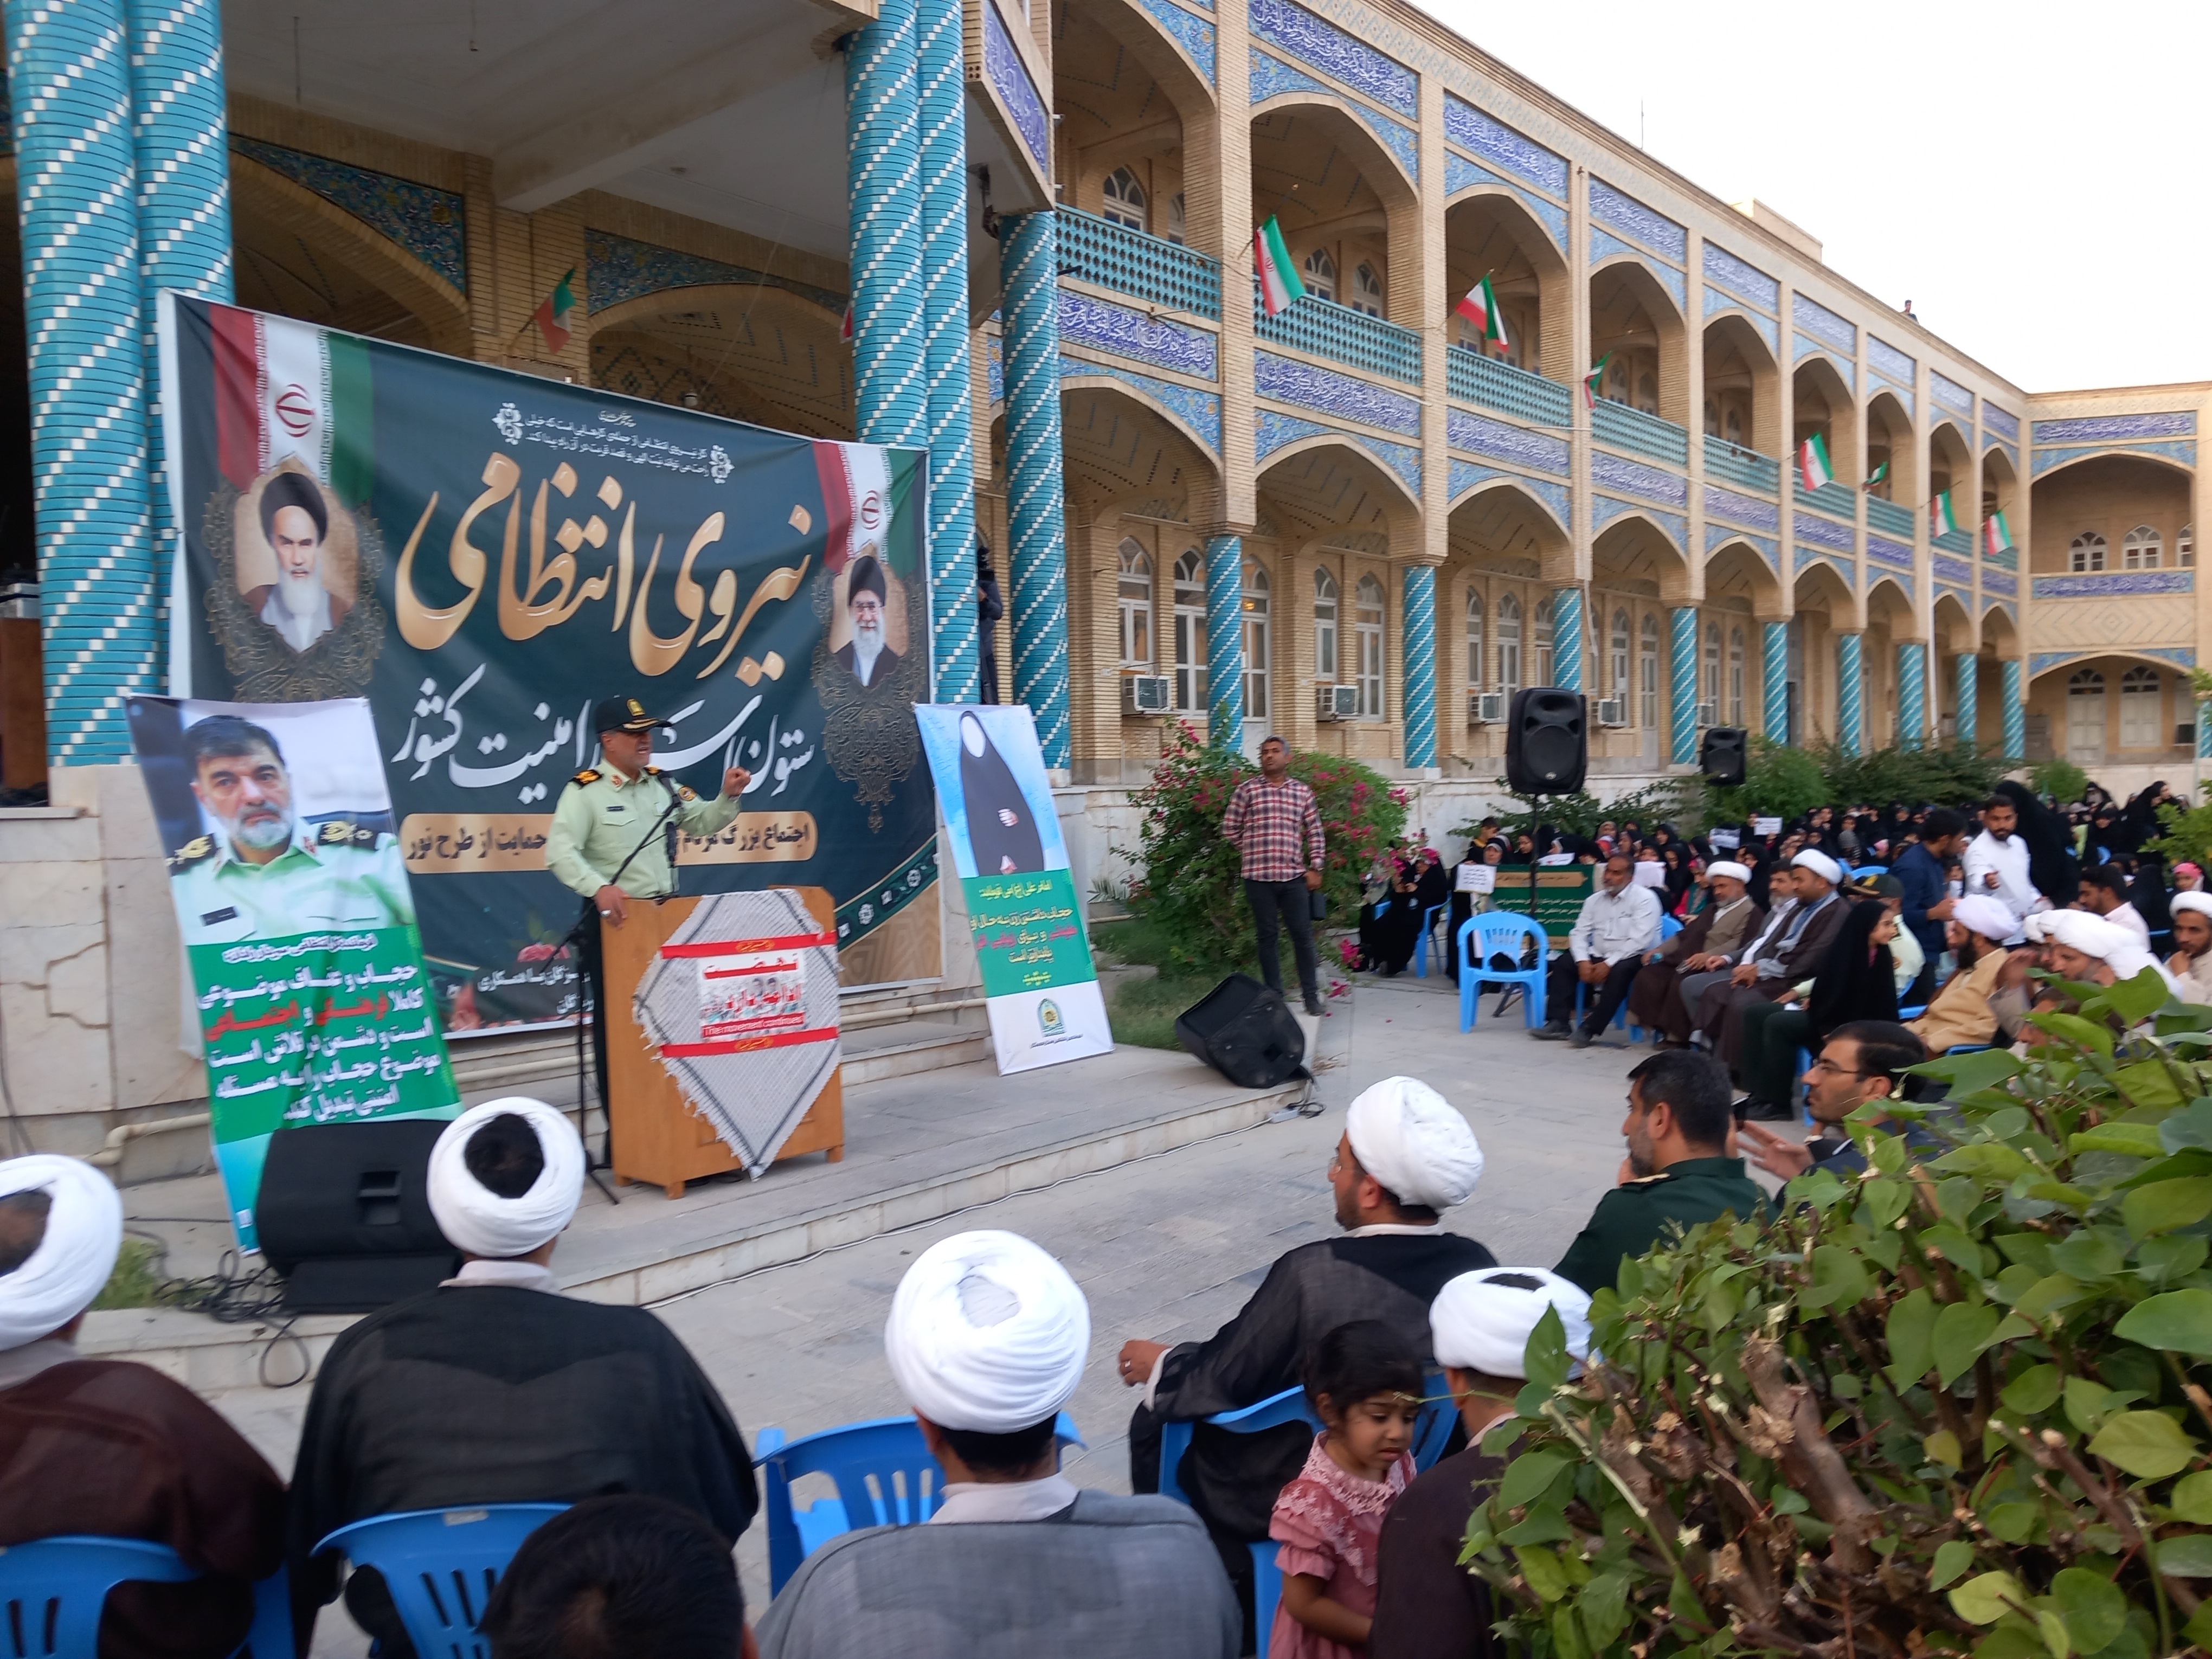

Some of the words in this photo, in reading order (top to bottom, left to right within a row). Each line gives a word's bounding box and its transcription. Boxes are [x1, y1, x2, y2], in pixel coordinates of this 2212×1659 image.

[394, 451, 636, 651] انتظامی
[629, 504, 812, 687] نیروی
[390, 662, 487, 782] کشور
[448, 698, 593, 805] امنیت
[732, 714, 815, 798] ستون
[406, 827, 433, 860] نور
[435, 826, 473, 859] طرح
[476, 826, 494, 859] از
[494, 826, 548, 856] حمایت
[722, 824, 761, 852] بزرگ
[762, 822, 811, 851] اجتماع
[288, 966, 344, 990] عفاف
[344, 973, 356, 993] و
[355, 962, 419, 990] حجاب
[197, 975, 289, 1010] موضوعی
[204, 999, 300, 1043] اجتماعی
[303, 1005, 314, 1027] و
[389, 1015, 434, 1043] است
[208, 1037, 263, 1068] است
[263, 1030, 305, 1064] تلاش
[304, 1033, 321, 1059] در
[320, 1025, 377, 1057] دشمن
[378, 1031, 390, 1051] و
[278, 1070, 305, 1091] به
[304, 1062, 324, 1092] را
[323, 1059, 378, 1088] حجاب
[379, 1049, 442, 1081] موضوع
[283, 1094, 313, 1121] کند
[313, 1089, 356, 1122] تبدیل
[355, 1082, 400, 1117] امنیتی
